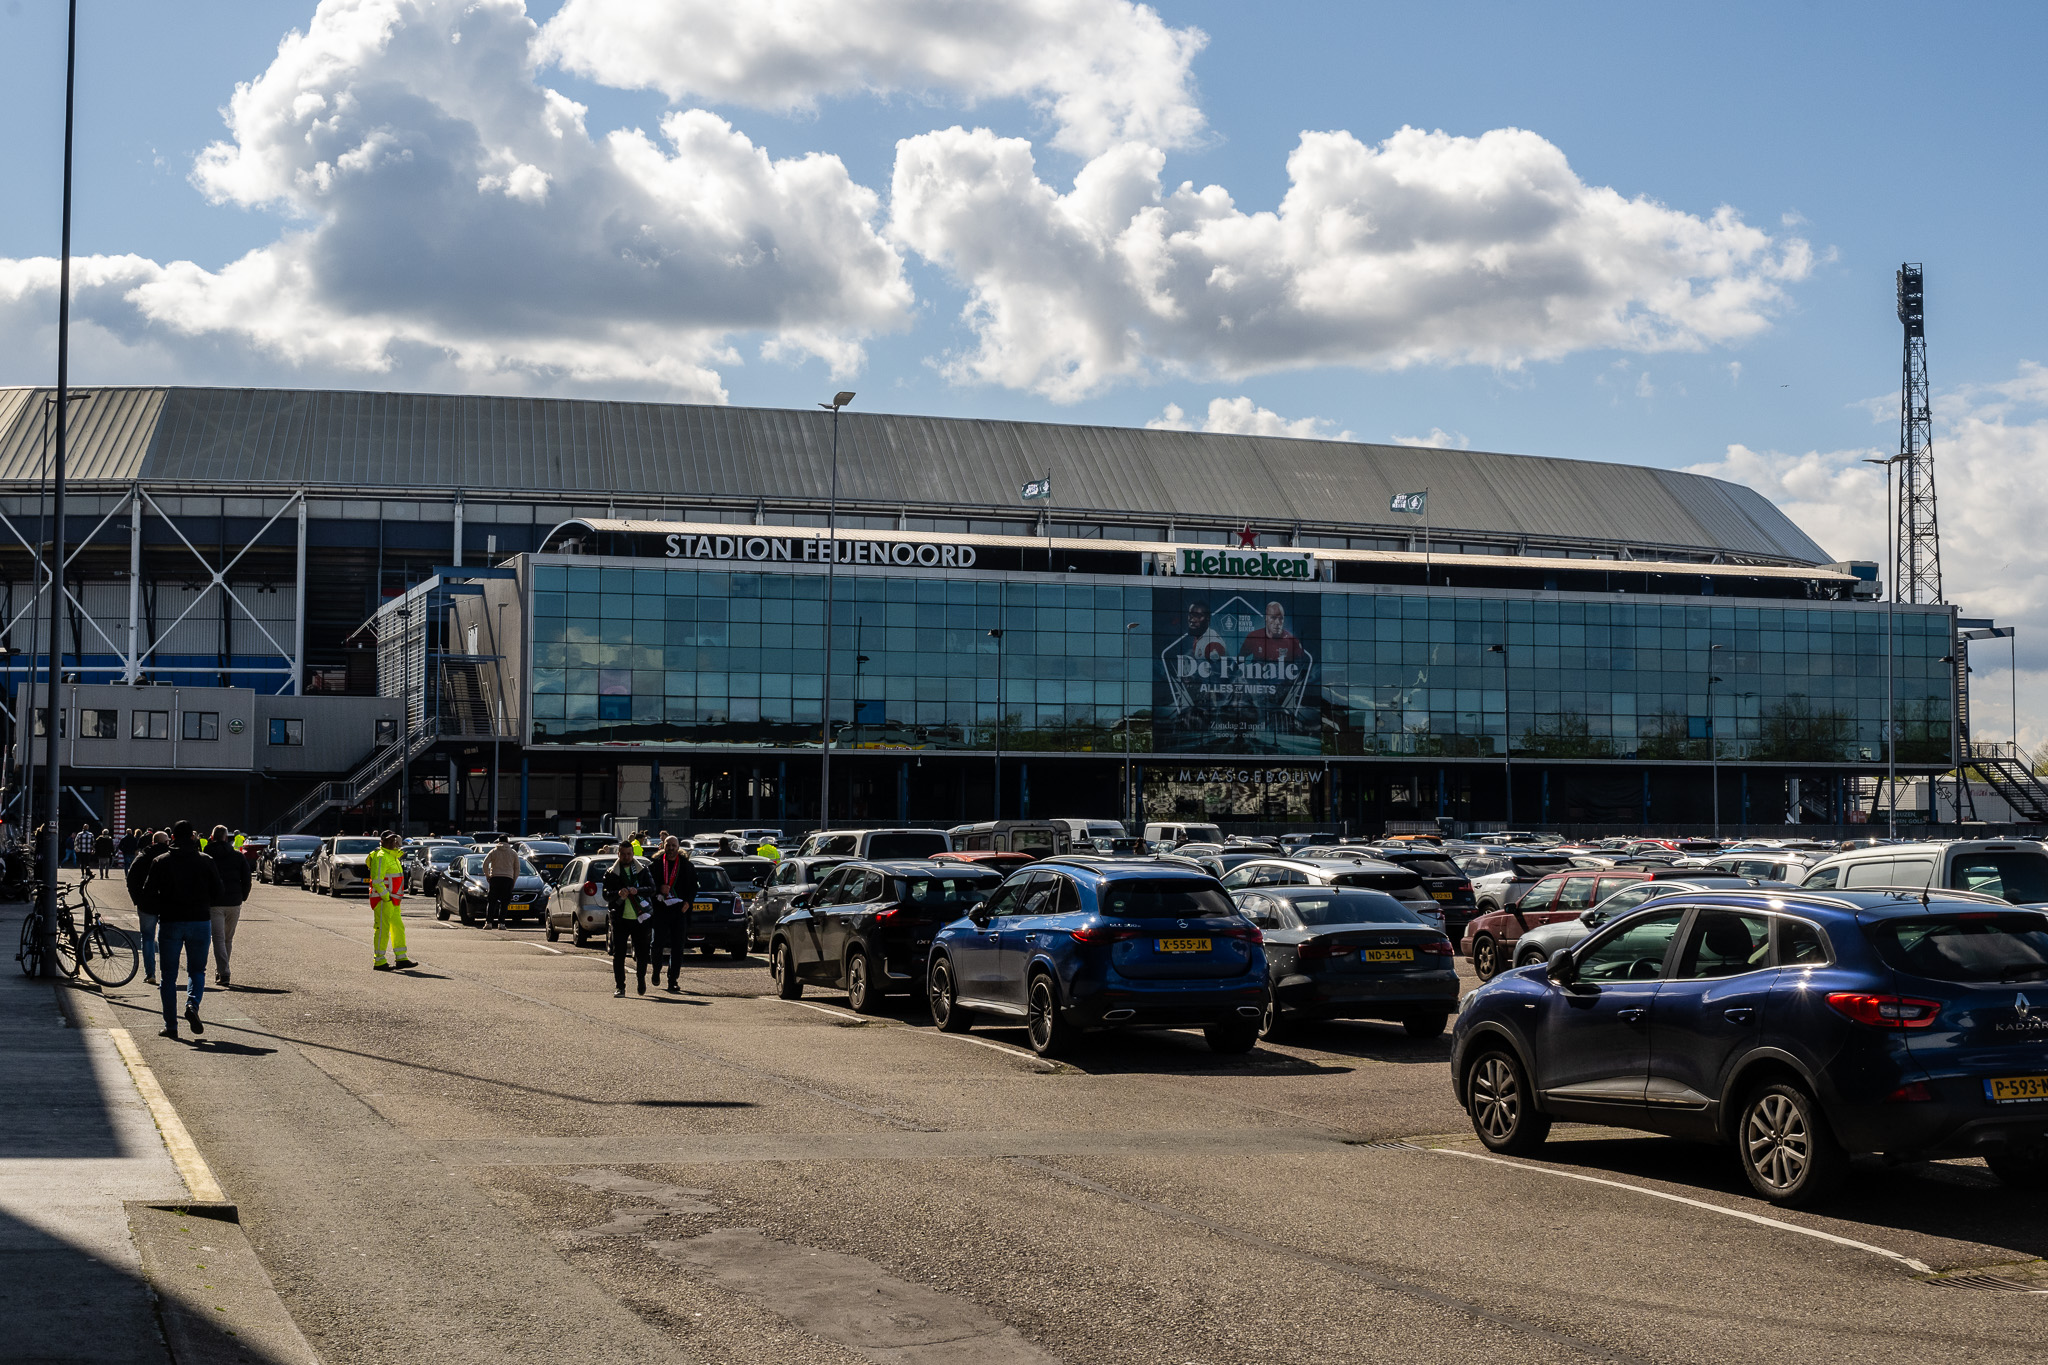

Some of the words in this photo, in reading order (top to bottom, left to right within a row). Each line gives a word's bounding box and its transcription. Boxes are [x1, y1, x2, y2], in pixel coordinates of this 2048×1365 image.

[665, 534, 792, 561] STADION
[803, 539, 977, 568] FEIJENOORD
[1183, 550, 1311, 577] Heineken
[1176, 654, 1212, 679] De
[1220, 656, 1299, 681] Finale
[1199, 683, 1234, 693] ALLES
[1244, 685, 1276, 695] NIETS
[1210, 721, 1239, 731] Zondag
[1248, 721, 1266, 731] april
[1179, 769, 1323, 783] MAASGEBOUW
[1163, 939, 1208, 950] X-555-JK
[1368, 950, 1412, 960] ND-346-L
[1995, 1021, 2048, 1031] KADJAR
